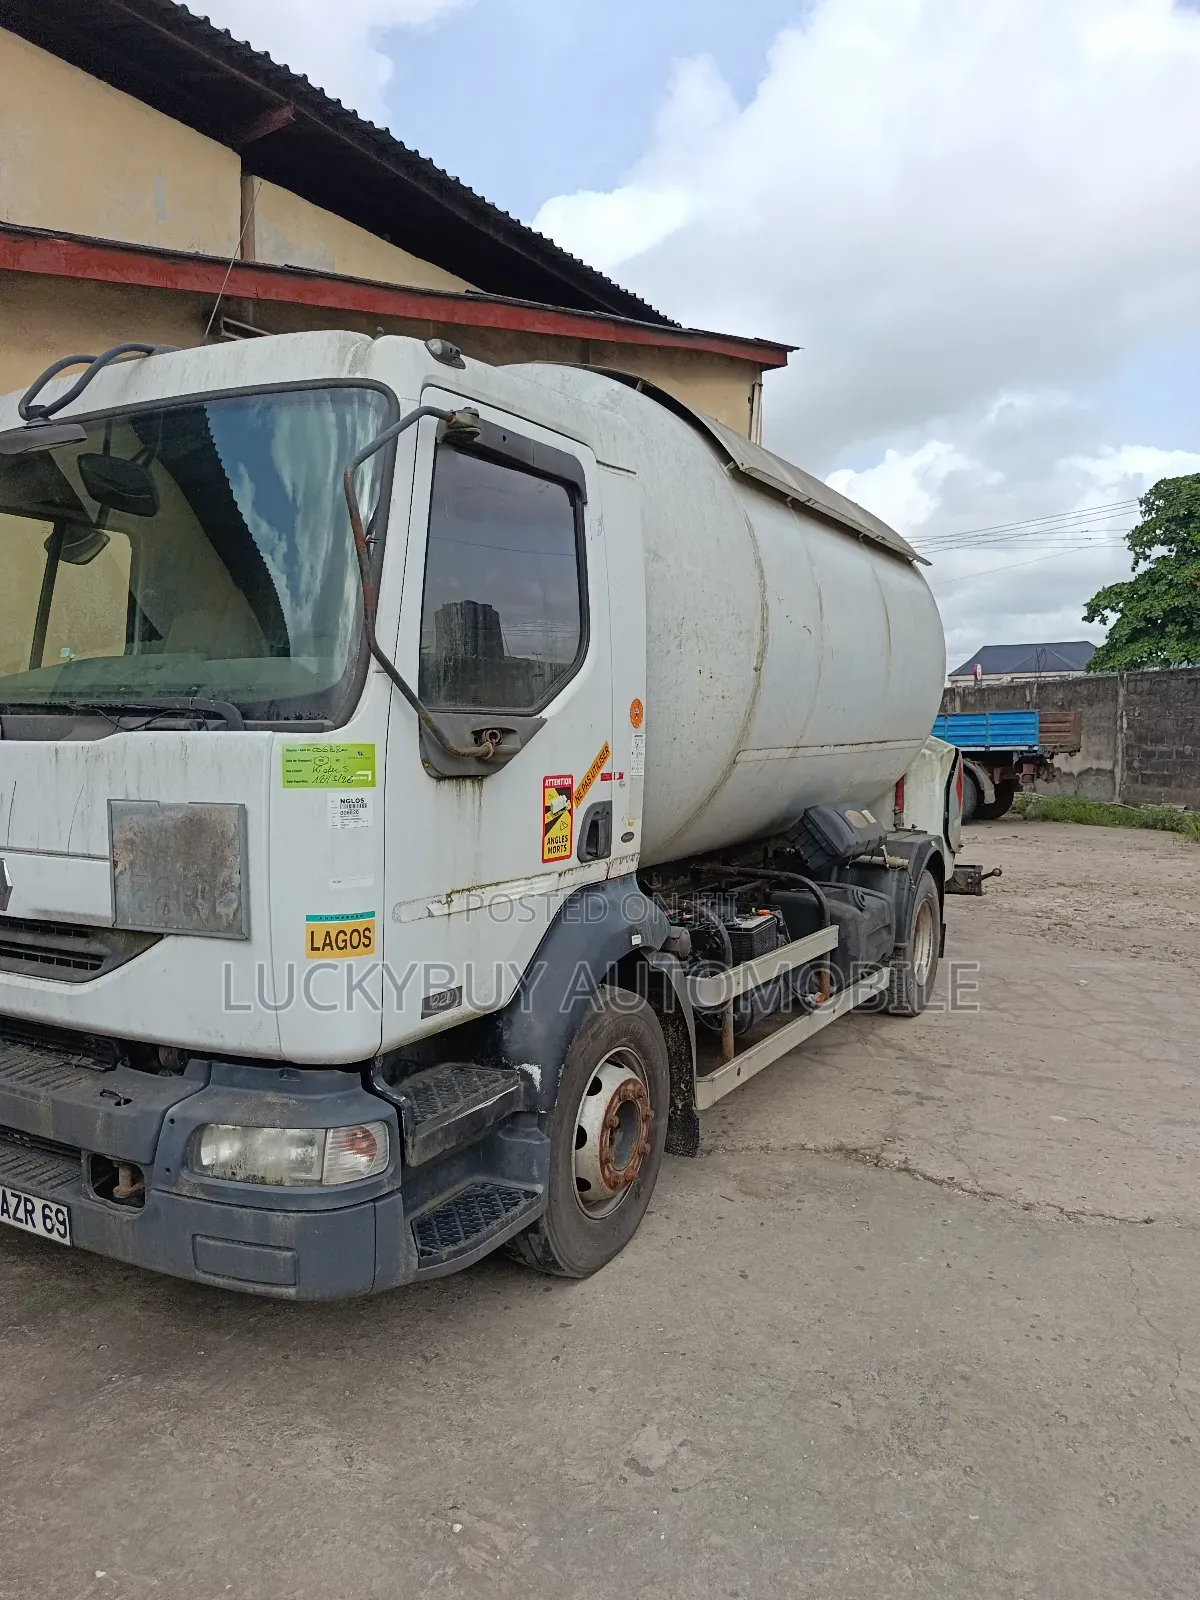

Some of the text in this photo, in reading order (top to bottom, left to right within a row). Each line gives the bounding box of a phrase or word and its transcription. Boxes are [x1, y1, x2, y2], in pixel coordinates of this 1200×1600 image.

[545, 777, 572, 786] ATTENTION
[575, 745, 610, 803] NE PAS UTILISER
[547, 835, 568, 845] ANGLES
[547, 844, 567, 854] MORTS
[310, 927, 372, 952] LAGOS
[0, 1188, 68, 1240] AZR 69
